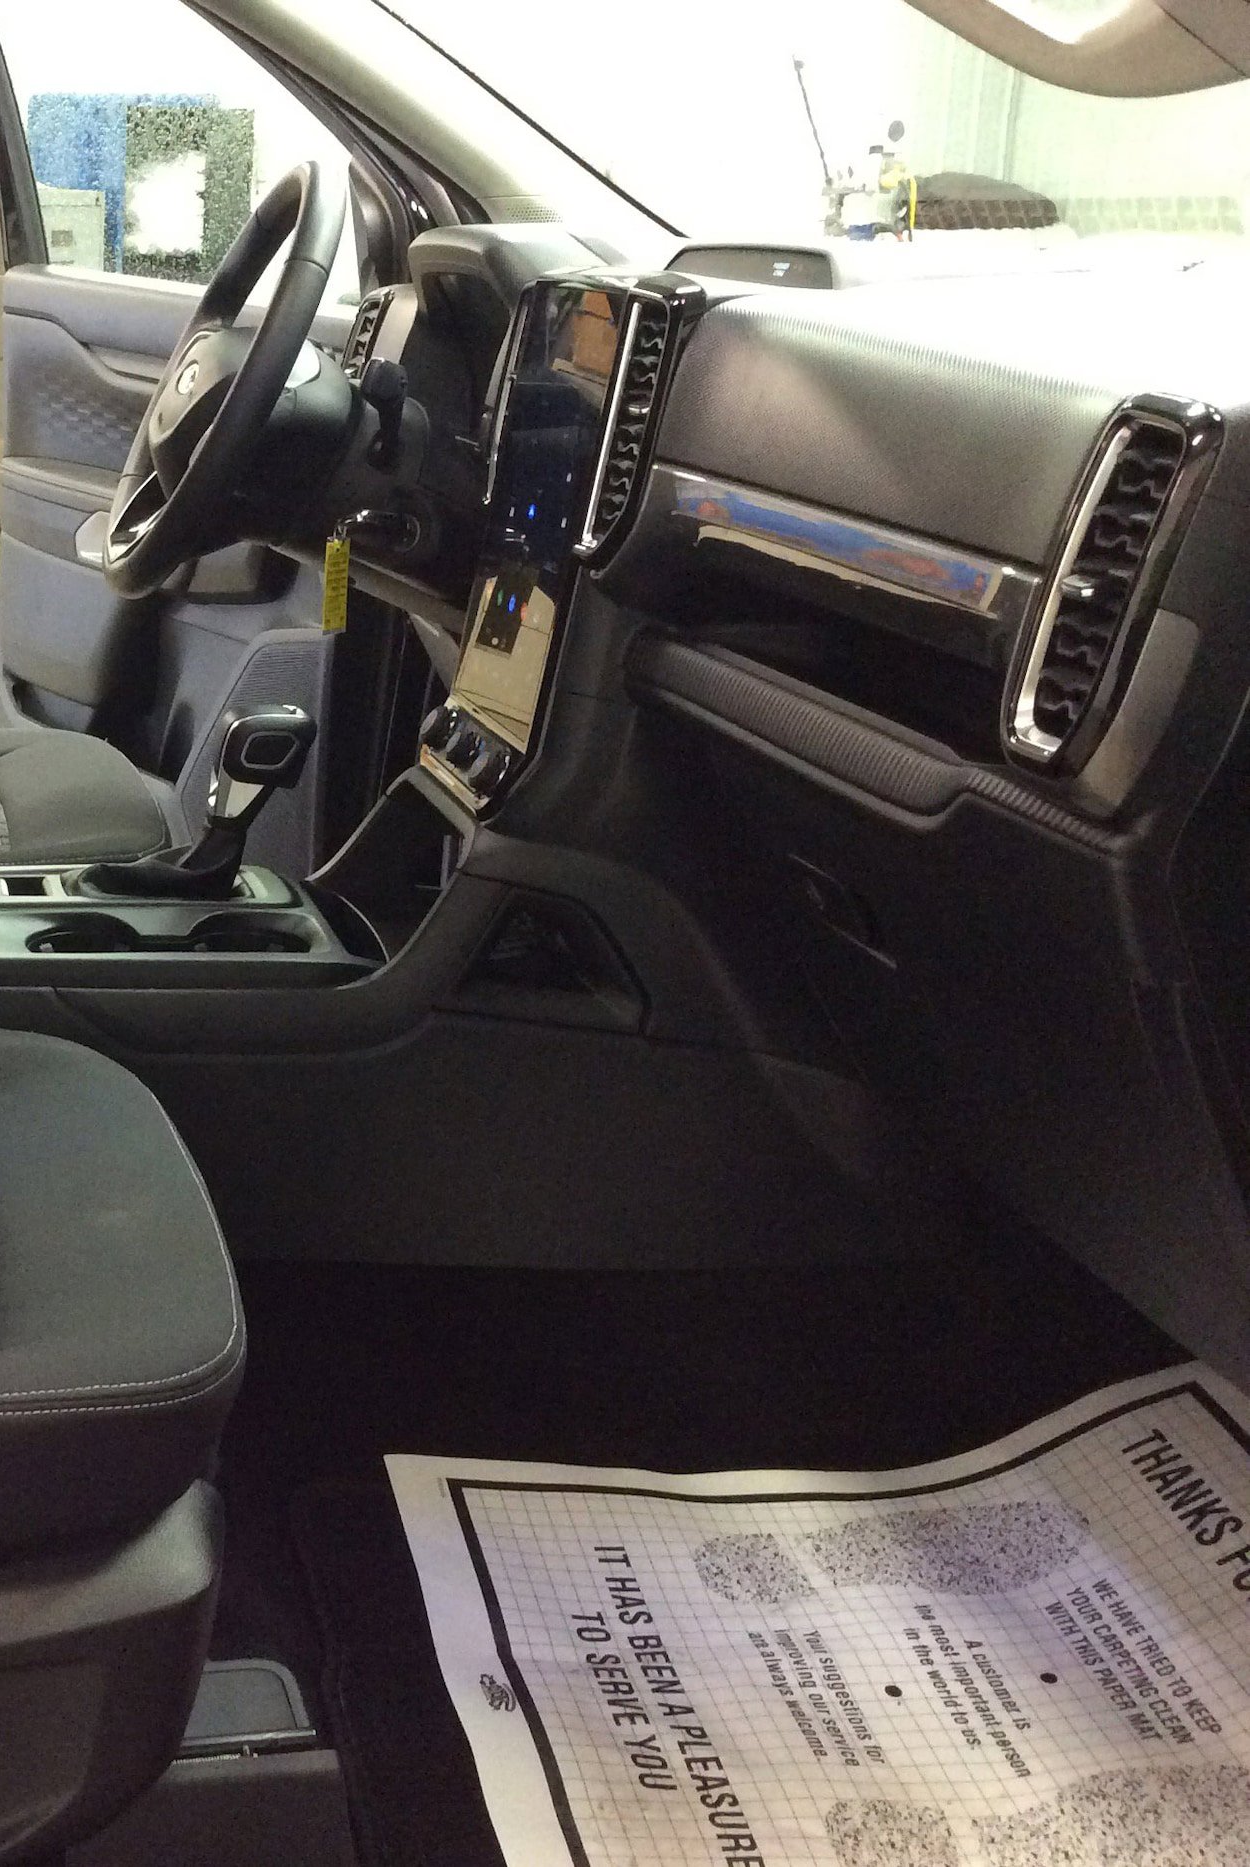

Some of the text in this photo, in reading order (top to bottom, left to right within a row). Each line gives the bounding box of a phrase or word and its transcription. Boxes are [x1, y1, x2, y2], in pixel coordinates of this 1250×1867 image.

[1122, 1428, 1243, 1545] THANKS
[572, 1611, 678, 1791] TO SERVE YOU
[594, 1546, 765, 1867] IT HAS BEEN A PLEASURE
[748, 1631, 828, 1762] are always welcome.
[803, 1630, 885, 1764] Your suggestions for
[903, 1627, 982, 1750] in the world to us.
[928, 1624, 960, 1657] most
[949, 1661, 1002, 1727] important
[986, 1730, 1031, 1778] person
[963, 1639, 1031, 1730] A customer is
[1045, 1601, 1163, 1740] WITH THIS PAPER MAT
[1066, 1587, 1195, 1744] YOUR CARPETING CLEAN
[1092, 1578, 1222, 1734] WE HAVE TRIED TO KEEP
[808, 1693, 830, 1716] our
[822, 1719, 860, 1767] service
